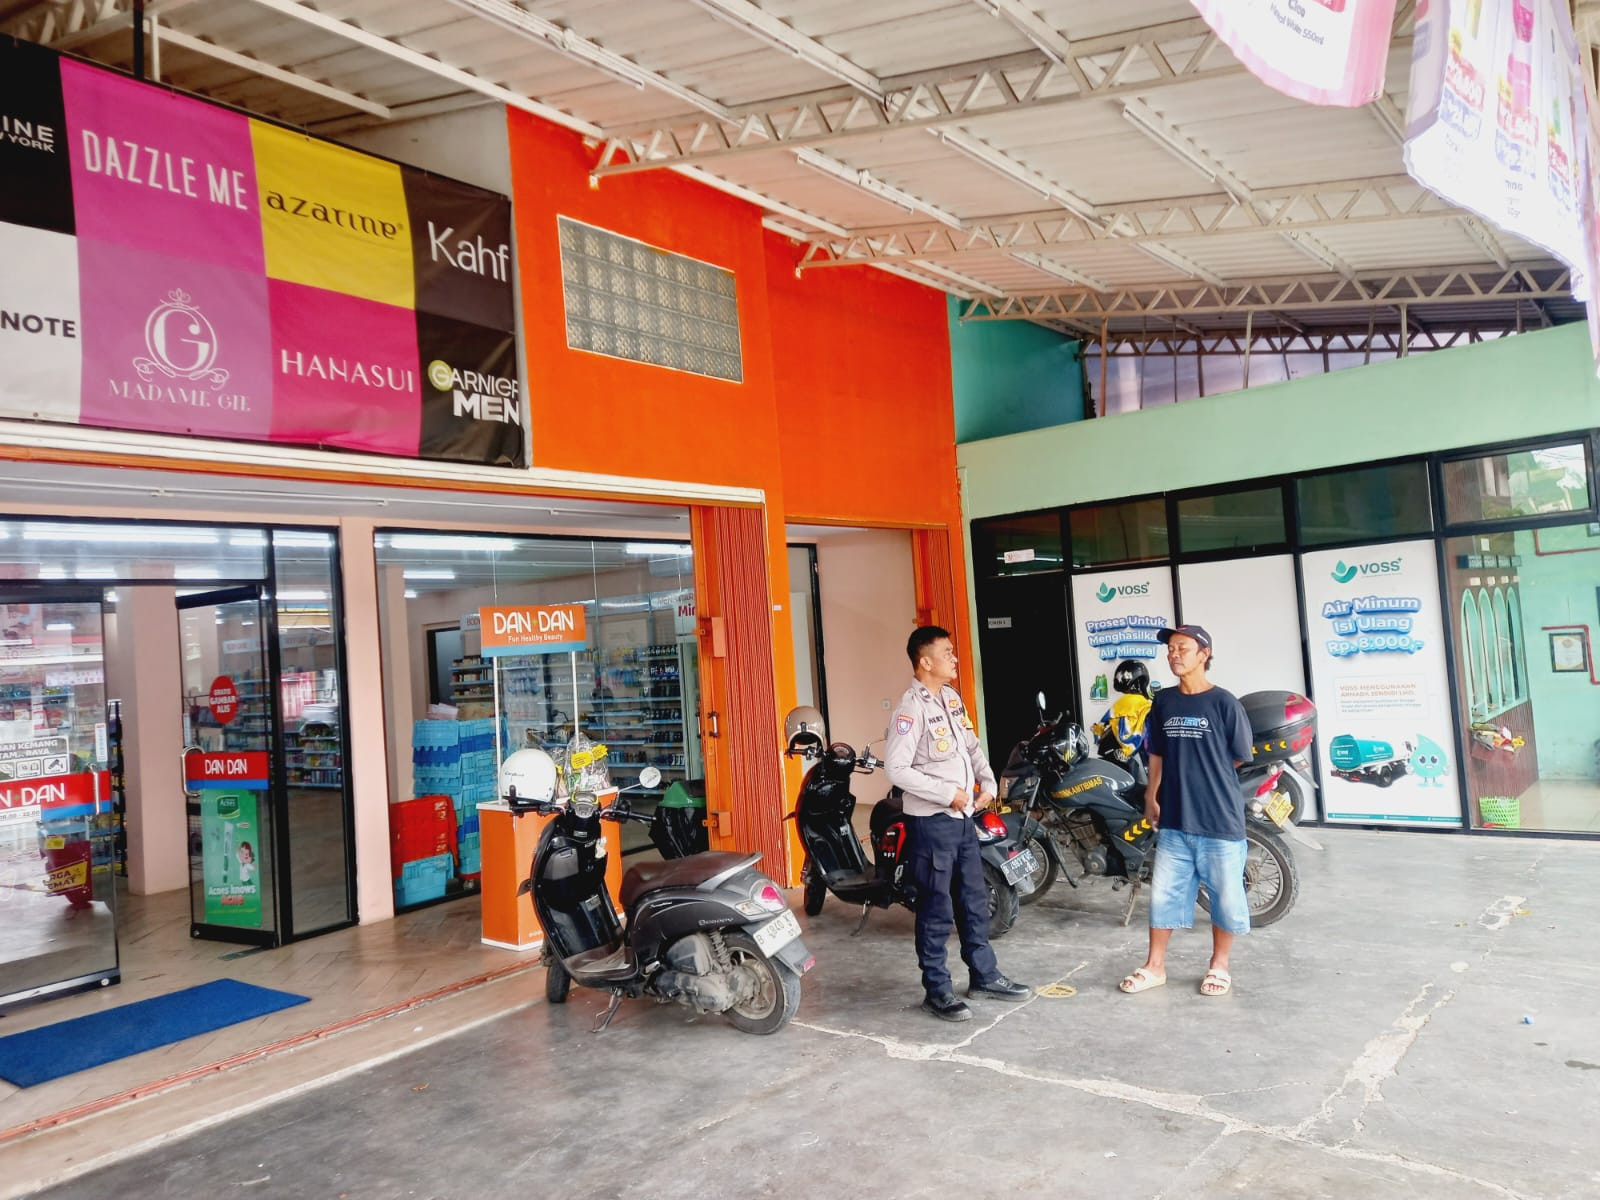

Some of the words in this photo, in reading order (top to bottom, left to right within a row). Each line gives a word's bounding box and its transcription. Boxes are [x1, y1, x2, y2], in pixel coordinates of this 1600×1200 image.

[9, 135, 55, 154] YORK
[82, 129, 197, 198] DAZZLE
[206, 164, 248, 211] ME
[428, 221, 509, 283] Kahf
[0, 309, 77, 339] NOTE
[281, 350, 414, 392] HANASUI
[109, 379, 210, 408] MADAME
[452, 392, 520, 425] MEN
[1360, 561, 1400, 574] VOSS
[1117, 583, 1149, 596] VOSS
[1323, 601, 1349, 616] Air
[1353, 598, 1419, 612] Minum
[493, 611, 532, 635] DAN
[538, 609, 574, 632] DAN
[1086, 617, 1127, 631] Proses
[1128, 616, 1166, 628] Untuk
[1334, 620, 1354, 633] Isi
[1358, 617, 1410, 630] Ulang
[508, 635, 519, 643] Fun
[1327, 641, 1354, 654] Rp.
[1099, 648, 1116, 658] Air
[1118, 646, 1156, 658] Mineral
[205, 759, 225, 775] DAN
[227, 759, 248, 775] DAN
[21, 782, 66, 806] DAN
